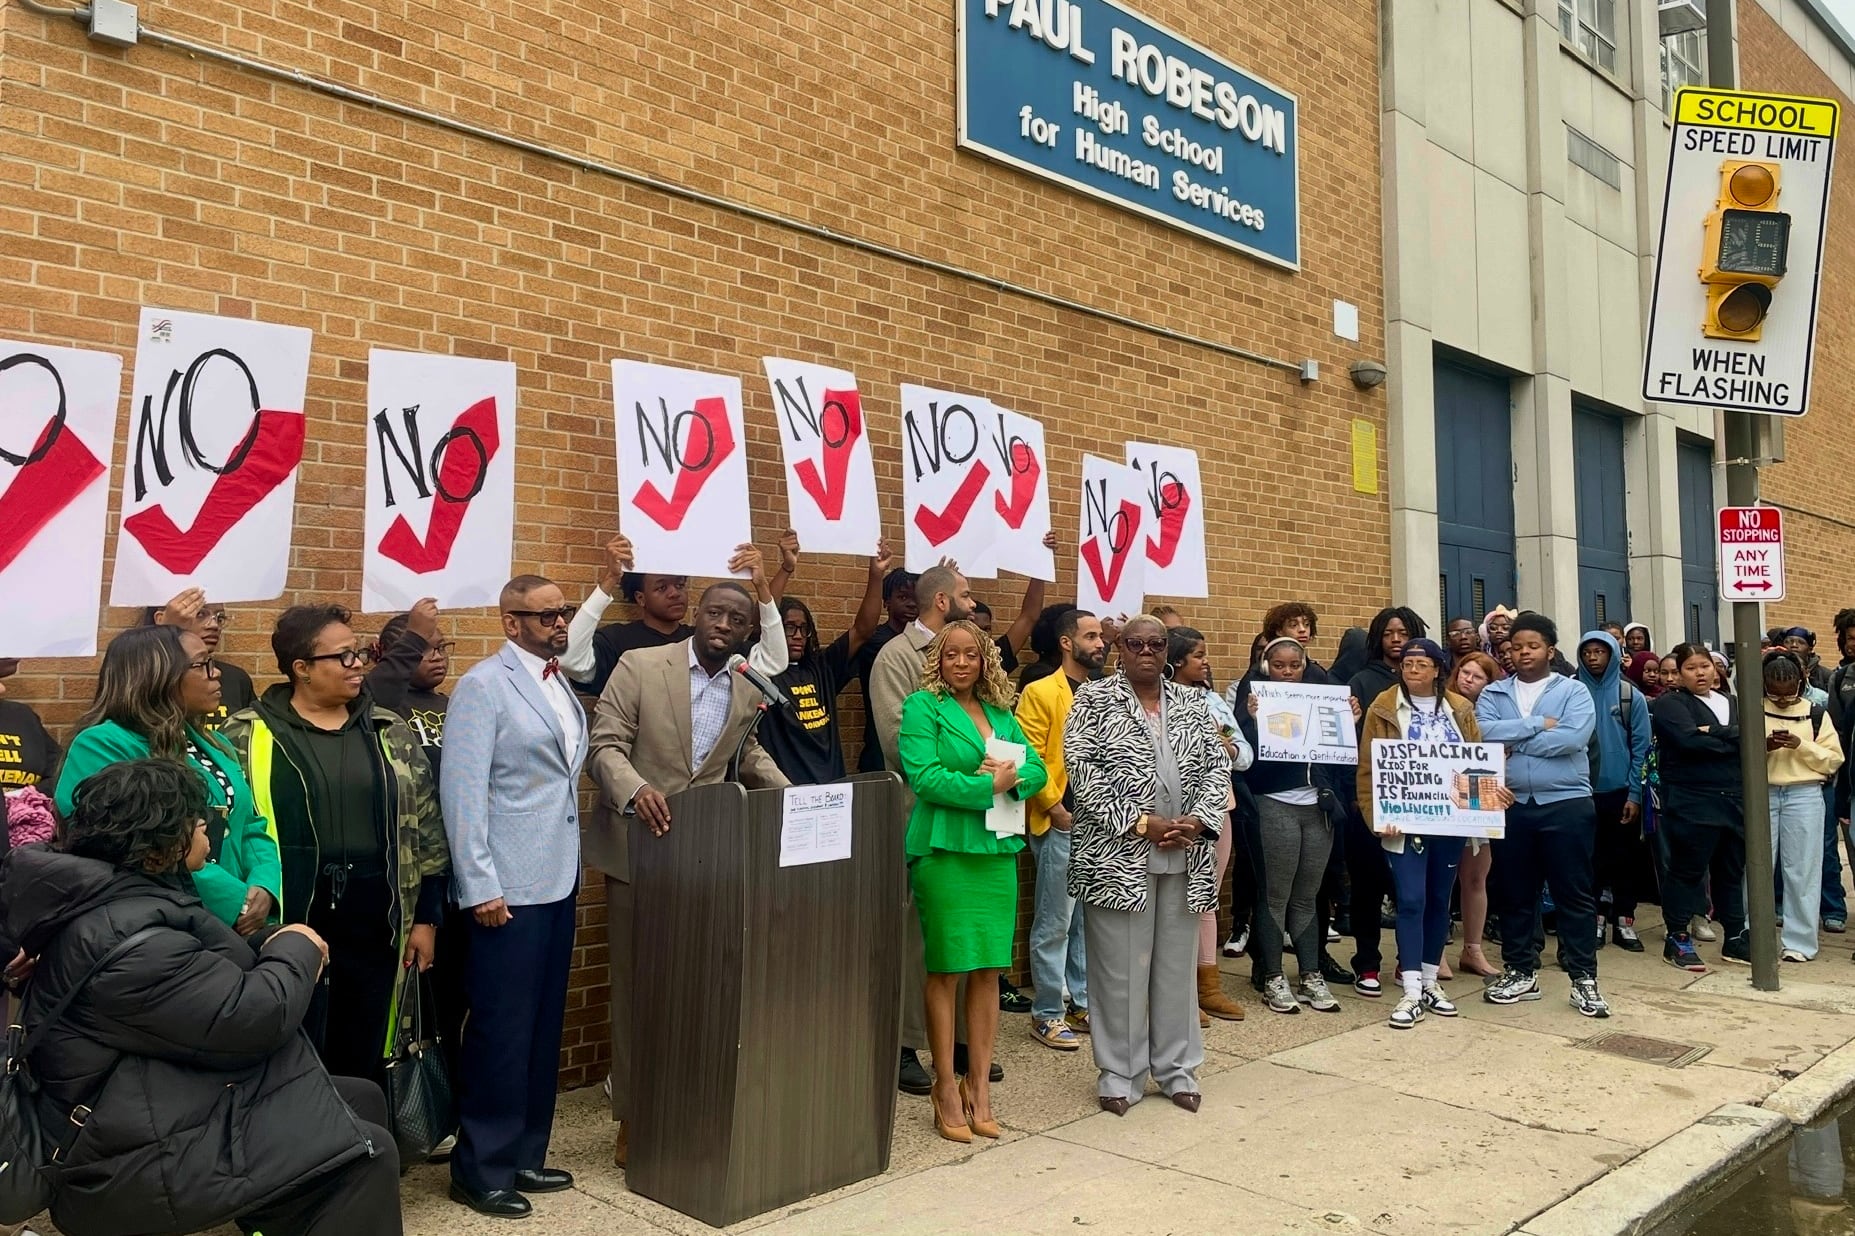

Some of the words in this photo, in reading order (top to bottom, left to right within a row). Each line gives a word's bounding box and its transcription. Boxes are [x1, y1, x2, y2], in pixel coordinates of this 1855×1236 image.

[1111, 27, 1285, 155] ROBESON
[1696, 98, 1816, 131] SCHOOL
[1073, 81, 1129, 135] High
[1142, 115, 1223, 175] School
[1684, 129, 1755, 155] SPEED
[1766, 136, 1821, 162] LIMIT
[1019, 105, 1060, 147] for
[1075, 127, 1160, 190] Human
[1172, 170, 1265, 231] Services
[1692, 348, 1766, 377] WHEN
[1659, 372, 1789, 406] FLASHING
[134, 347, 260, 503] NO
[904, 401, 979, 483] NO
[1739, 510, 1761, 529] NO
[1723, 529, 1779, 541] STOPPING
[1734, 550, 1768, 562] ANY
[1733, 565, 1770, 577] TIME
[1260, 745, 1300, 760] Education
[1380, 743, 1489, 761] DISPLACING
[1377, 759, 1406, 771] KIDS
[1409, 761, 1429, 771] FOR
[1379, 771, 1443, 786] FUNDING
[789, 794, 807, 806] TELL
[810, 795, 823, 804] THE
[1377, 784, 1398, 800] IS
[1401, 787, 1450, 801] FINANCIAL
[1380, 800, 1451, 816] VIOLENCE!!!
